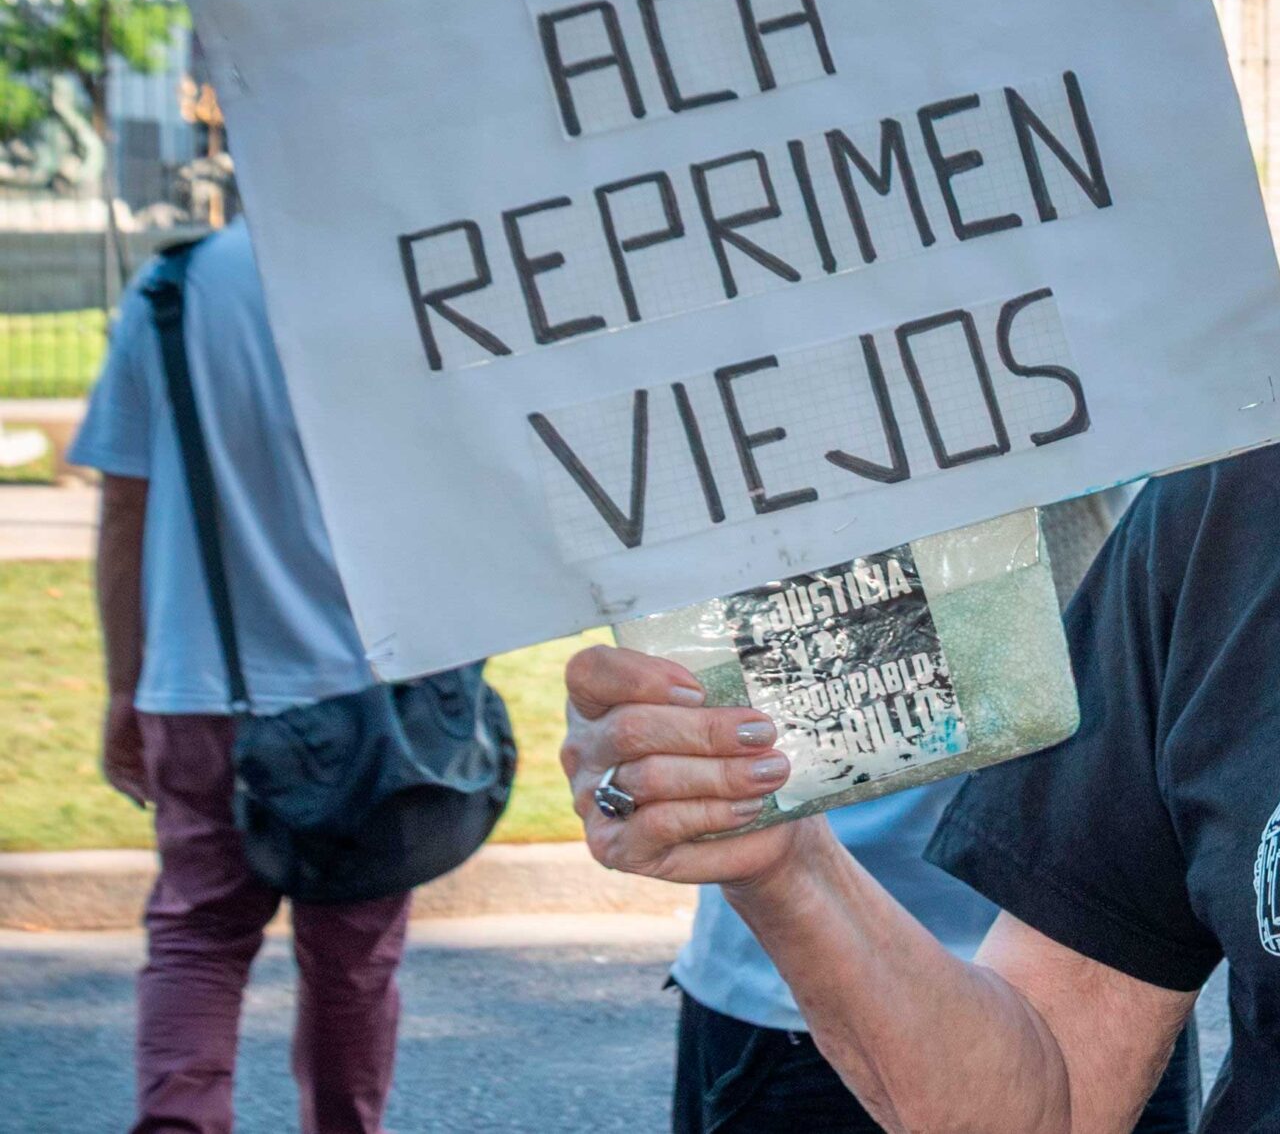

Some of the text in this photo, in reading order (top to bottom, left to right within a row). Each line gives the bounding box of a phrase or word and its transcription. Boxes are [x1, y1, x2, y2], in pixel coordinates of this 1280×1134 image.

[397, 70, 1113, 370] REPRIMEN
[527, 287, 1092, 547] VIEJOS
[787, 652, 936, 719] POR PABLO
